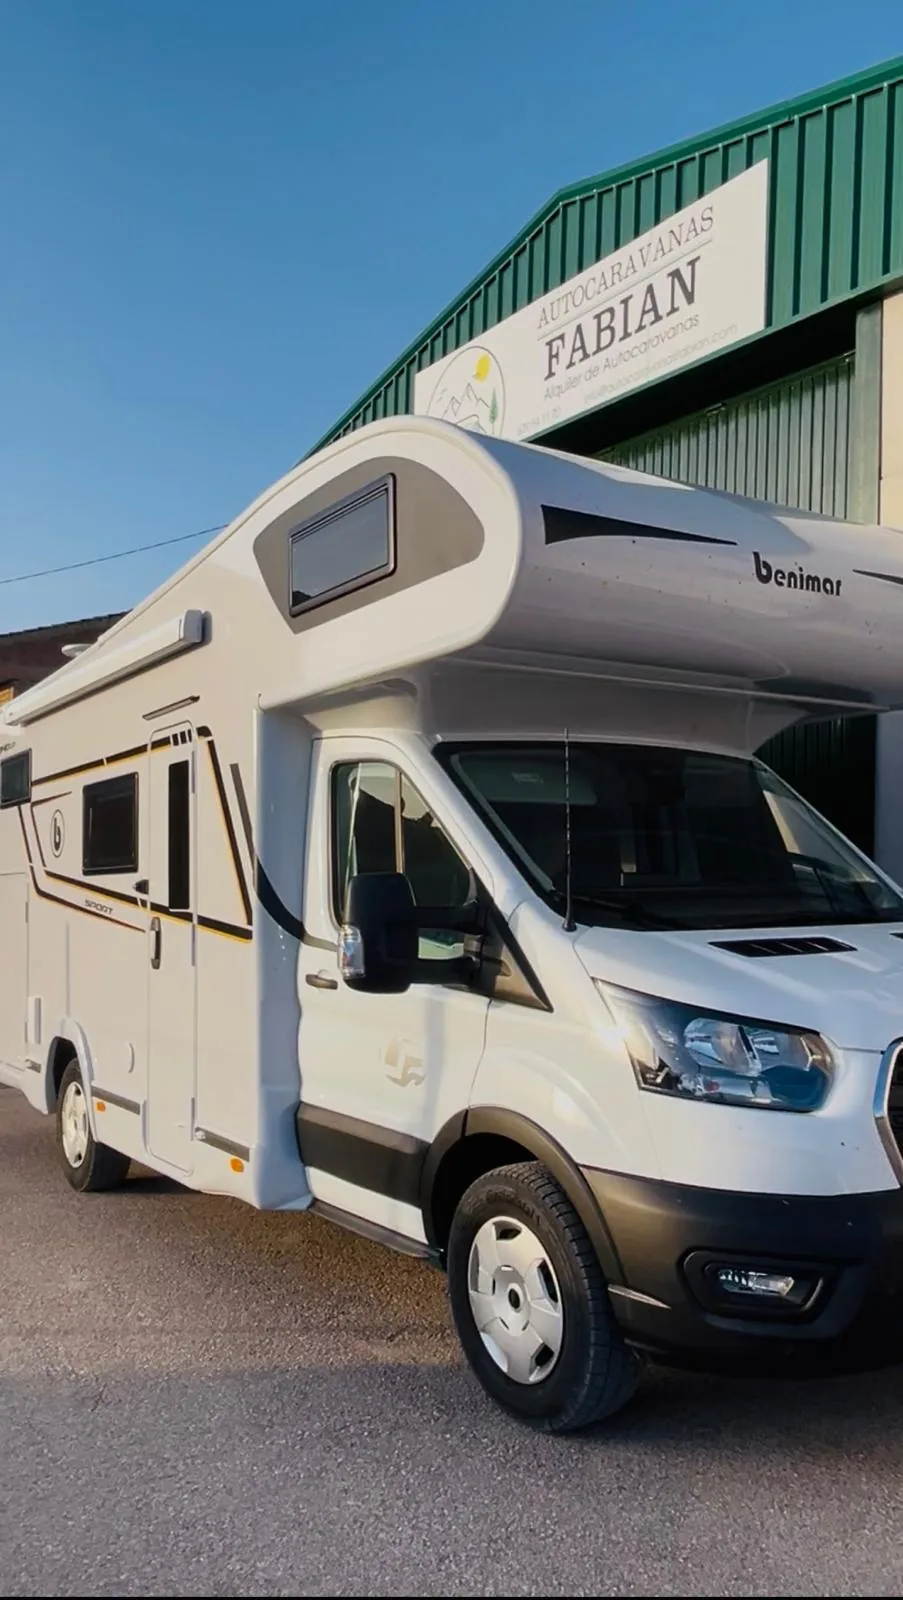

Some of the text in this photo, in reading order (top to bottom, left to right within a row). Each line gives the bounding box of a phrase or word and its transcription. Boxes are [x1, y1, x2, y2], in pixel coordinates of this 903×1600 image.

[537, 205, 714, 330] AUTOCARAVANAS
[543, 256, 702, 382] FABIAN
[543, 313, 700, 402] Alquiler de Autocaravanas
[752, 551, 842, 597] benimar
[84, 897, 114, 915] SPORT
